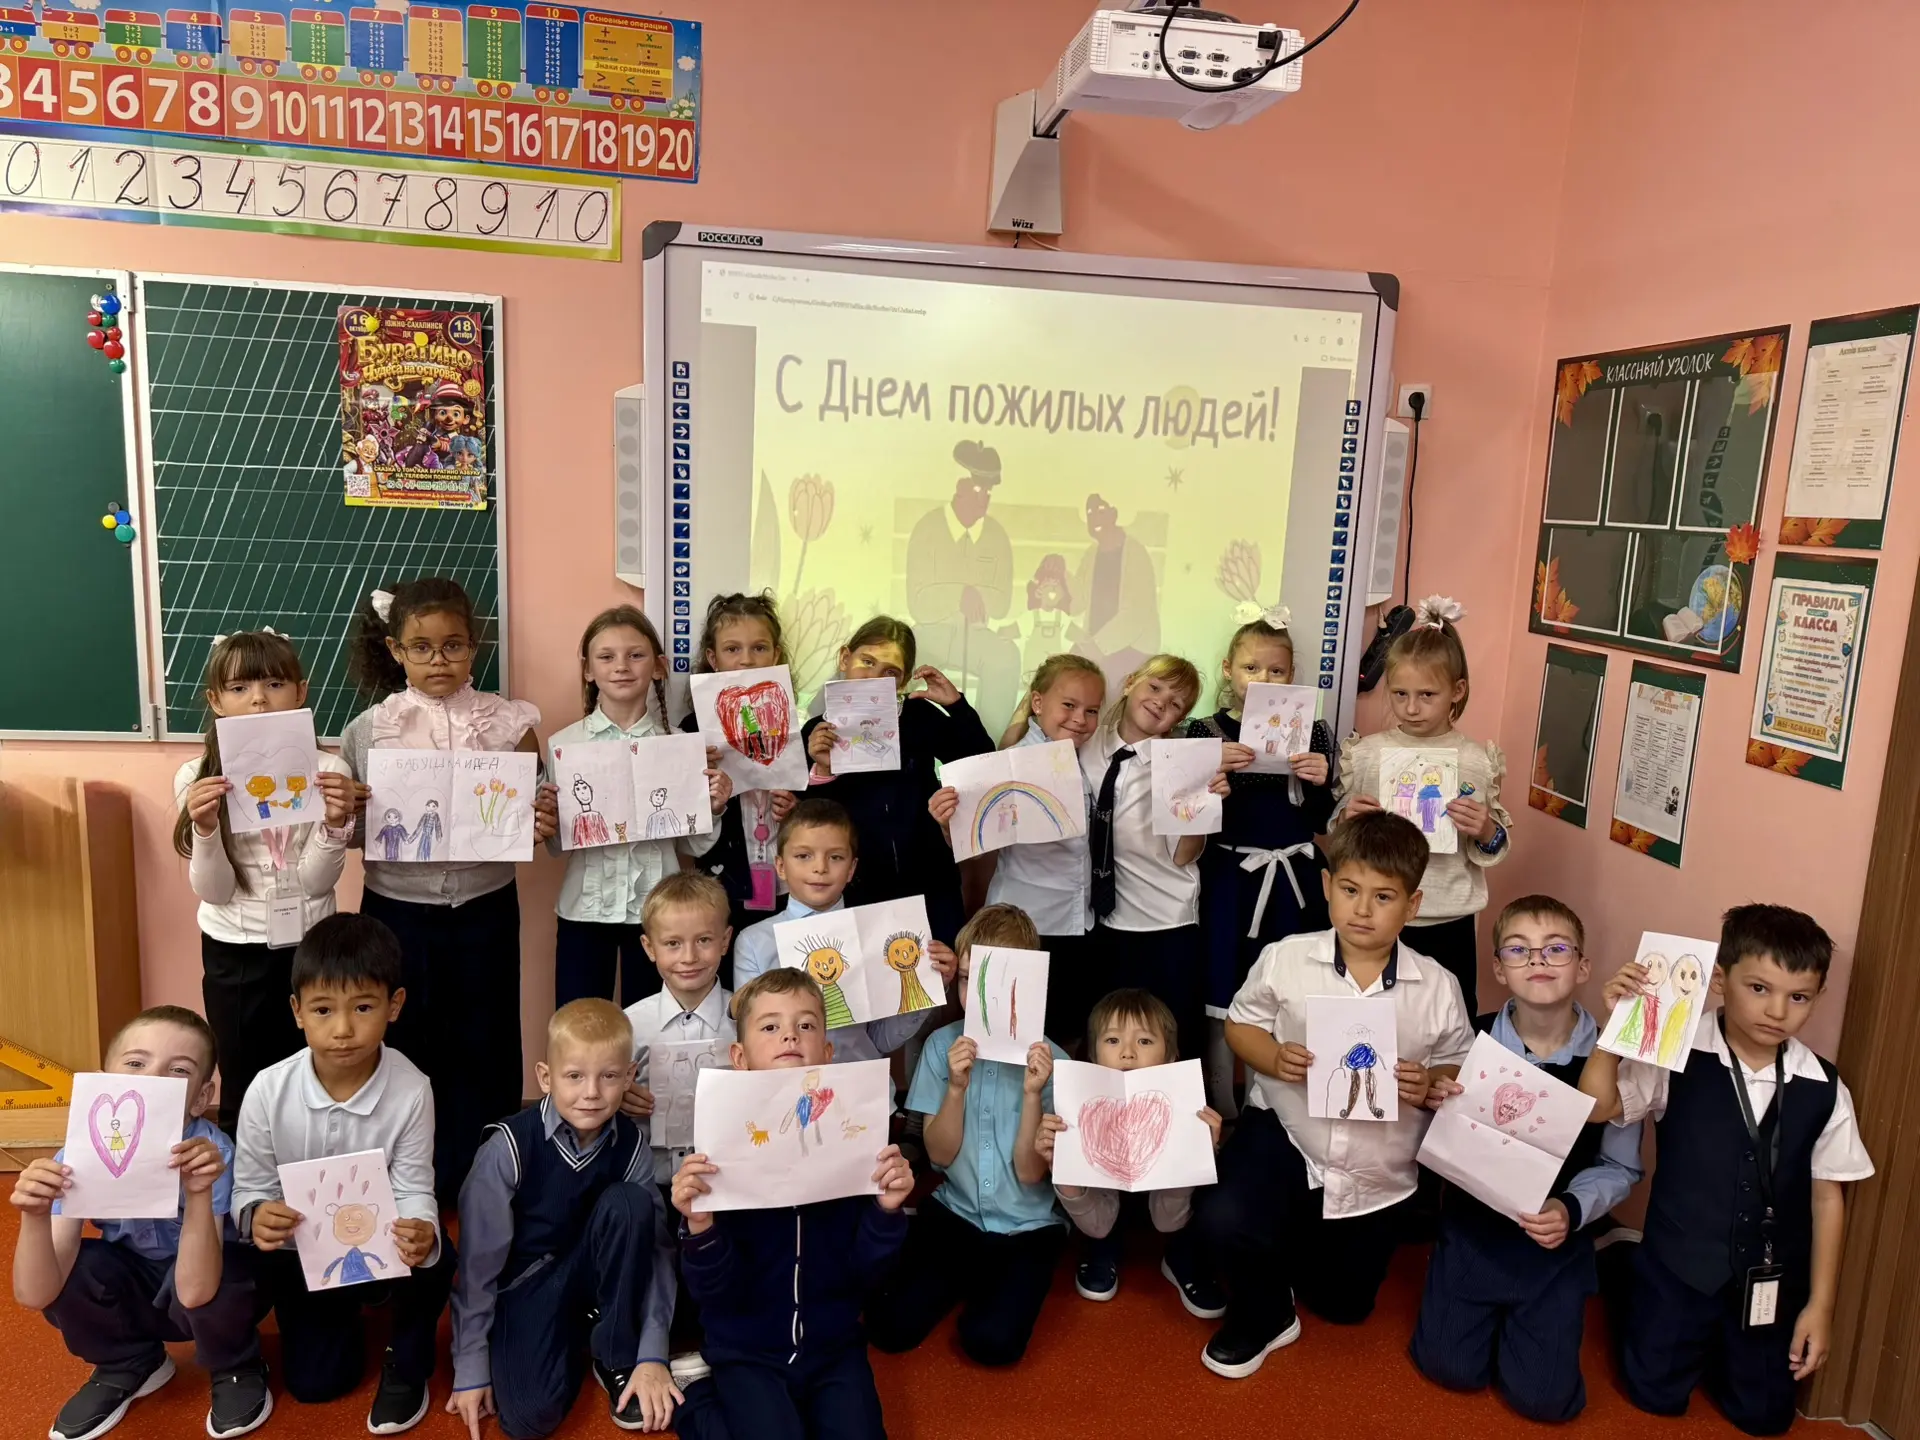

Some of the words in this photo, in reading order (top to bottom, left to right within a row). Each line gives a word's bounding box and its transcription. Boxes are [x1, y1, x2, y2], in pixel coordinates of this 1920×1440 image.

[3, 10, 8, 18] 1
[68, 13, 74, 21] 2
[129, 12, 136, 21] 3
[190, 13, 197, 22] 4
[254, 12, 260, 21] 5
[315, 12, 321, 21] 6
[373, 11, 379, 19] 7
[432, 9, 438, 18] 8
[490, 8, 497, 17] 9
[546, 8, 559, 18] 10
[589, 14, 628, 25] Основные
[630, 21, 667, 31] операции
[595, 62, 618, 70] Знаки
[620, 65, 660, 75] сравнения
[23, 68, 57, 112] 4
[68, 71, 97, 116] 5
[106, 74, 140, 120] 6
[148, 78, 178, 122] 7
[189, 82, 220, 126] 8
[231, 86, 264, 130] 9
[270, 90, 306, 136] 10
[311, 95, 344, 139] 11
[350, 100, 386, 143] 12
[388, 102, 424, 146] 13
[428, 105, 464, 150] 14
[467, 108, 503, 154] 15
[506, 112, 542, 156] 16
[545, 116, 580, 160] 17
[584, 120, 618, 163] 18
[621, 123, 655, 166] 19
[658, 128, 692, 171] 20
[6, 141, 39, 195] 0
[70, 146, 92, 199] 1
[116, 150, 148, 204] 2
[169, 156, 201, 209] 3
[226, 160, 252, 213] 4
[273, 164, 305, 216] 5
[324, 170, 357, 221] 6
[378, 173, 407, 226] 7
[425, 178, 456, 230] 8
[476, 182, 508, 234] 9
[700, 232, 762, 246] РОССКЛАСС
[385, 320, 442, 329] ЮЖНО-САХАЛИНСК
[454, 320, 471, 332] 18
[357, 336, 474, 370] Буратино
[1606, 354, 1664, 383] КЛАССНЫЙ
[1666, 352, 1714, 376] УГОЛОК
[776, 354, 803, 413] С
[819, 359, 930, 422] Днем
[948, 383, 1126, 434] пожилых
[1134, 386, 1280, 448] людей!
[1792, 593, 1846, 611] ПРАВИЛА
[1794, 616, 1837, 632] КЛАССА
